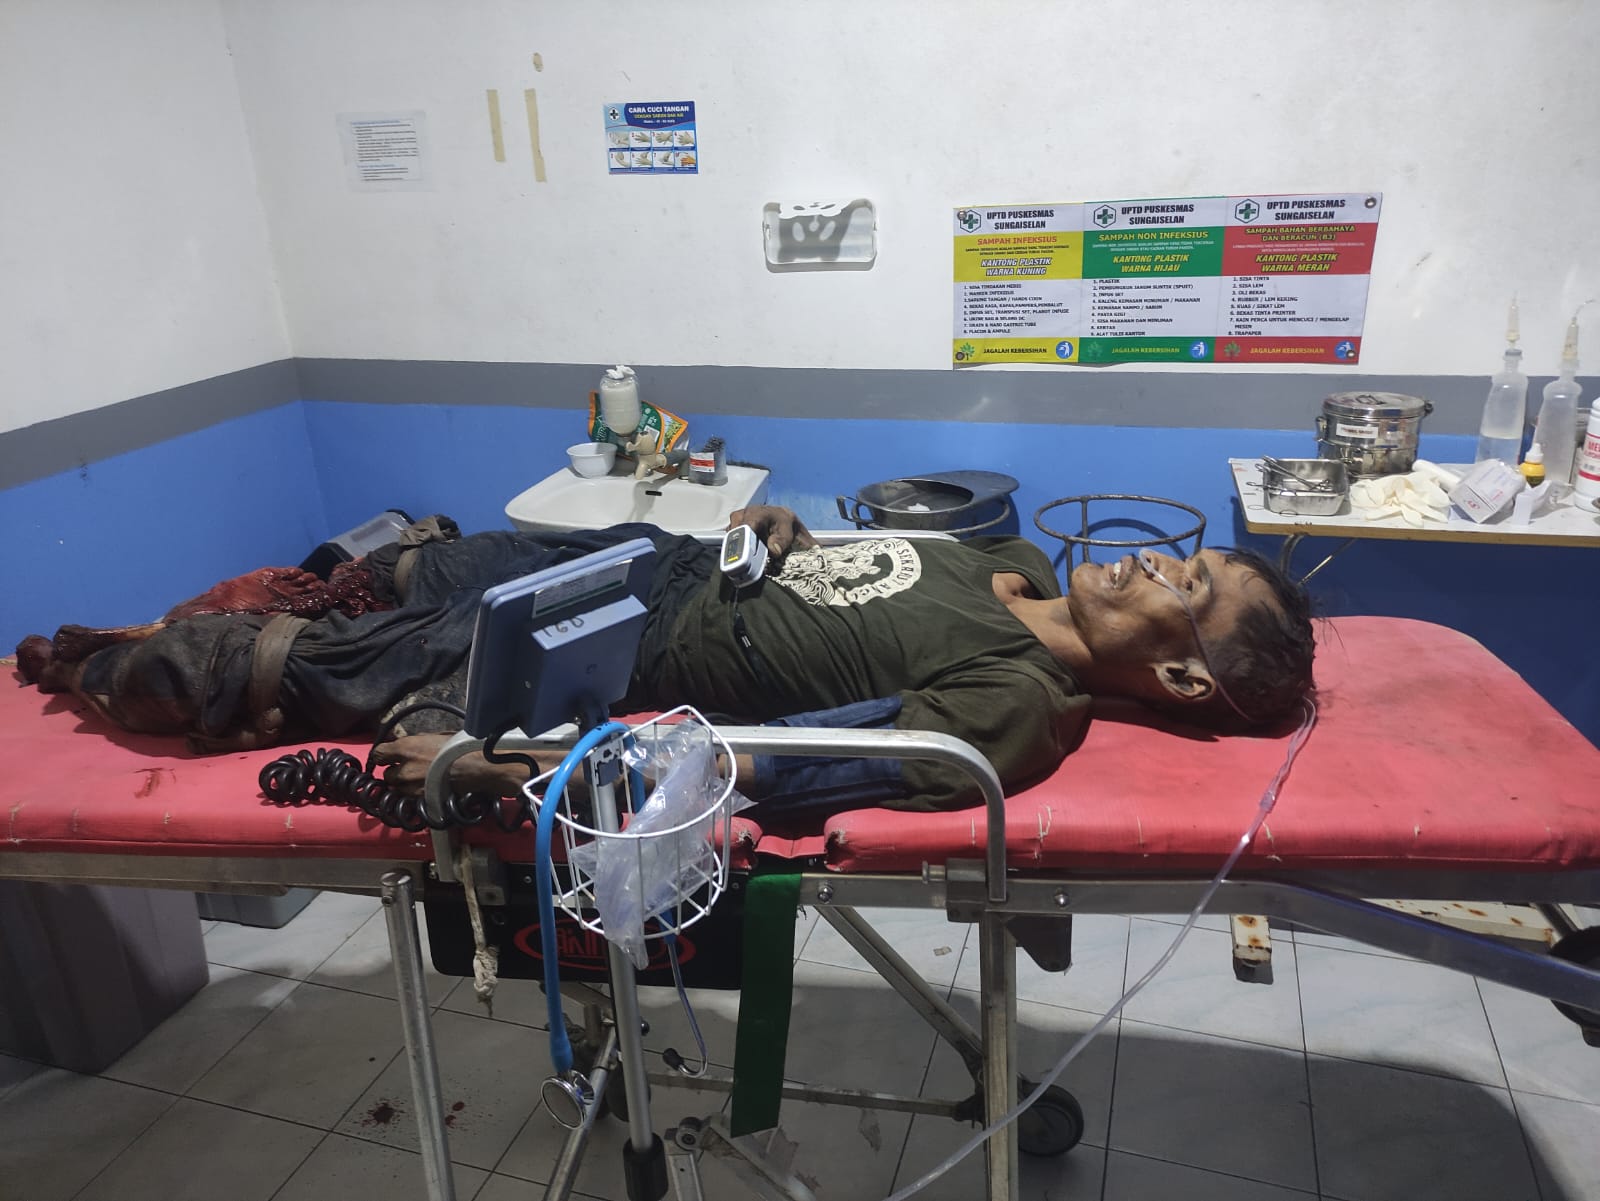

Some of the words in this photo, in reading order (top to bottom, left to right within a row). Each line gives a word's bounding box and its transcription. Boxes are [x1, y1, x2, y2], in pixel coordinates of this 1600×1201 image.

[1267, 201, 1290, 209] UPTD
[1292, 199, 1346, 208] PUSKESMAS
[1122, 206, 1142, 214] UPTD
[1144, 204, 1194, 213] PUSKESMAS
[987, 211, 1006, 219] UPTD
[1008, 210, 1054, 218] PUSKESMAS
[1275, 211, 1335, 220] SUNGAISELAN
[1129, 215, 1184, 225] SUNGAISELAN
[995, 220, 1046, 230] SUNGAISELAN
[1160, 231, 1208, 239] INFEKSIUS
[981, 259, 1017, 267] KANTONG
[1019, 257, 1052, 266] PLASTIK
[1113, 255, 1152, 263] KANTONG
[1154, 254, 1189, 262] PLASTIK
[1256, 254, 1297, 262] KANTONG
[1300, 253, 1338, 261] PLASTIK
[986, 268, 1014, 276] WARNA
[1016, 267, 1047, 275] KUNING
[1154, 264, 1180, 272] HIJAU
